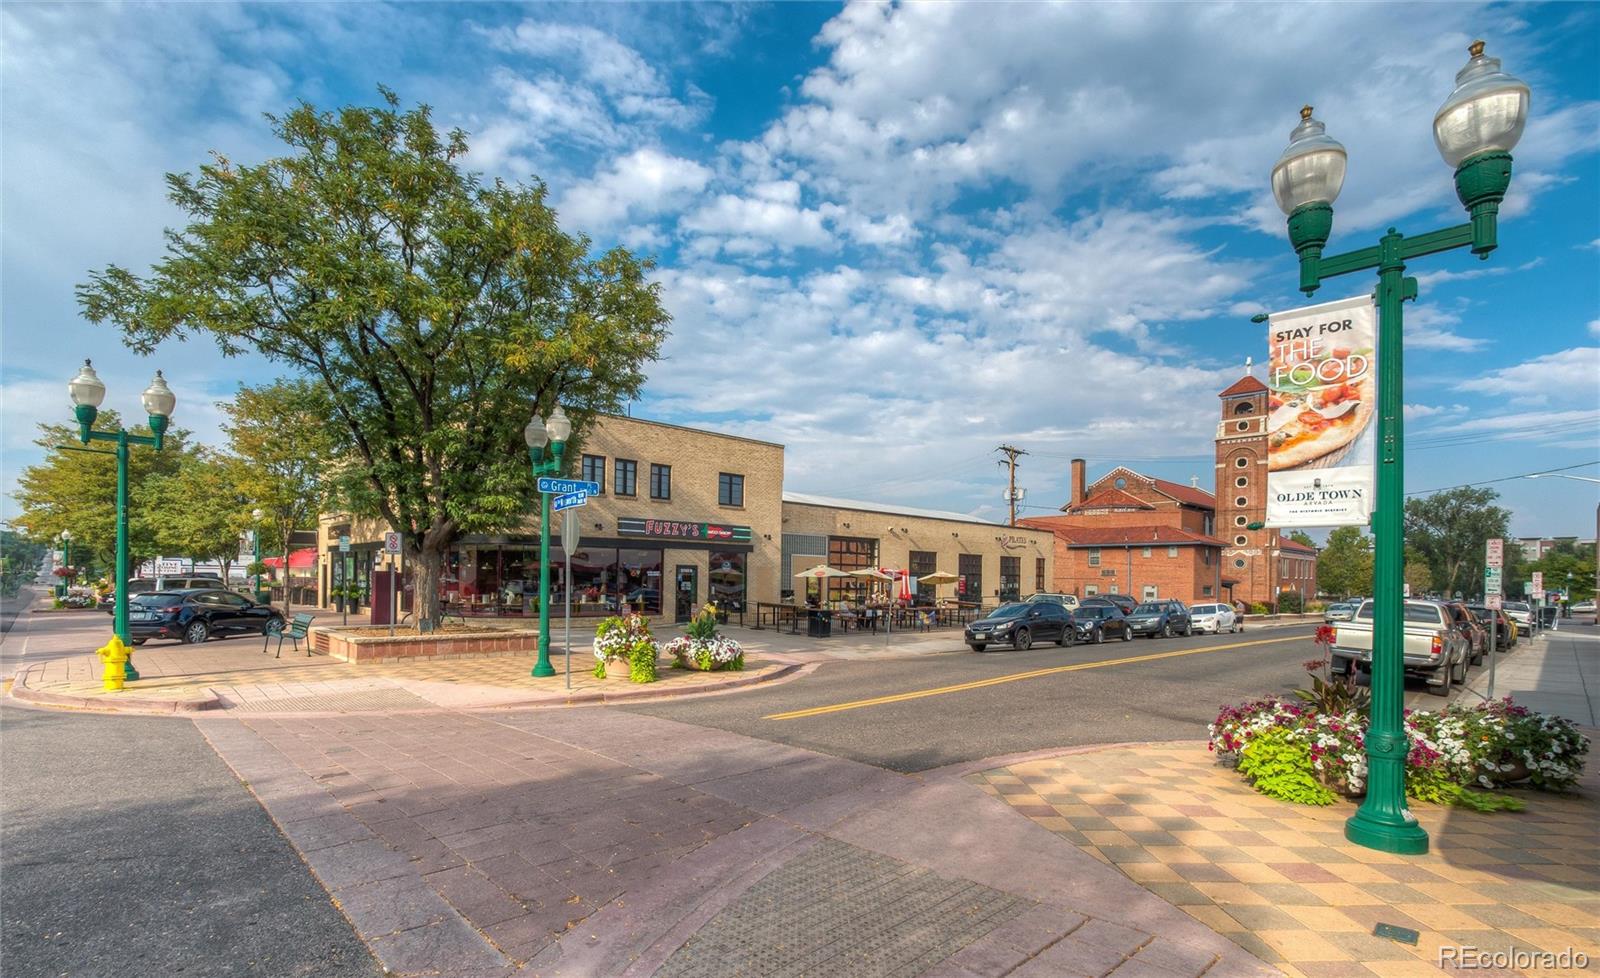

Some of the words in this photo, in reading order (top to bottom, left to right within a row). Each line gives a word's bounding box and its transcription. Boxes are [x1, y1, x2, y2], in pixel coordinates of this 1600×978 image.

[1276, 326, 1313, 342] STAY
[1319, 319, 1353, 335] FOR
[1276, 336, 1323, 363] THE
[1275, 355, 1368, 388] FOOD
[551, 480, 577, 493] Grant
[1277, 491, 1315, 503] OLDE
[1319, 488, 1363, 501] TOWN
[645, 519, 700, 537] FUZZY'S
